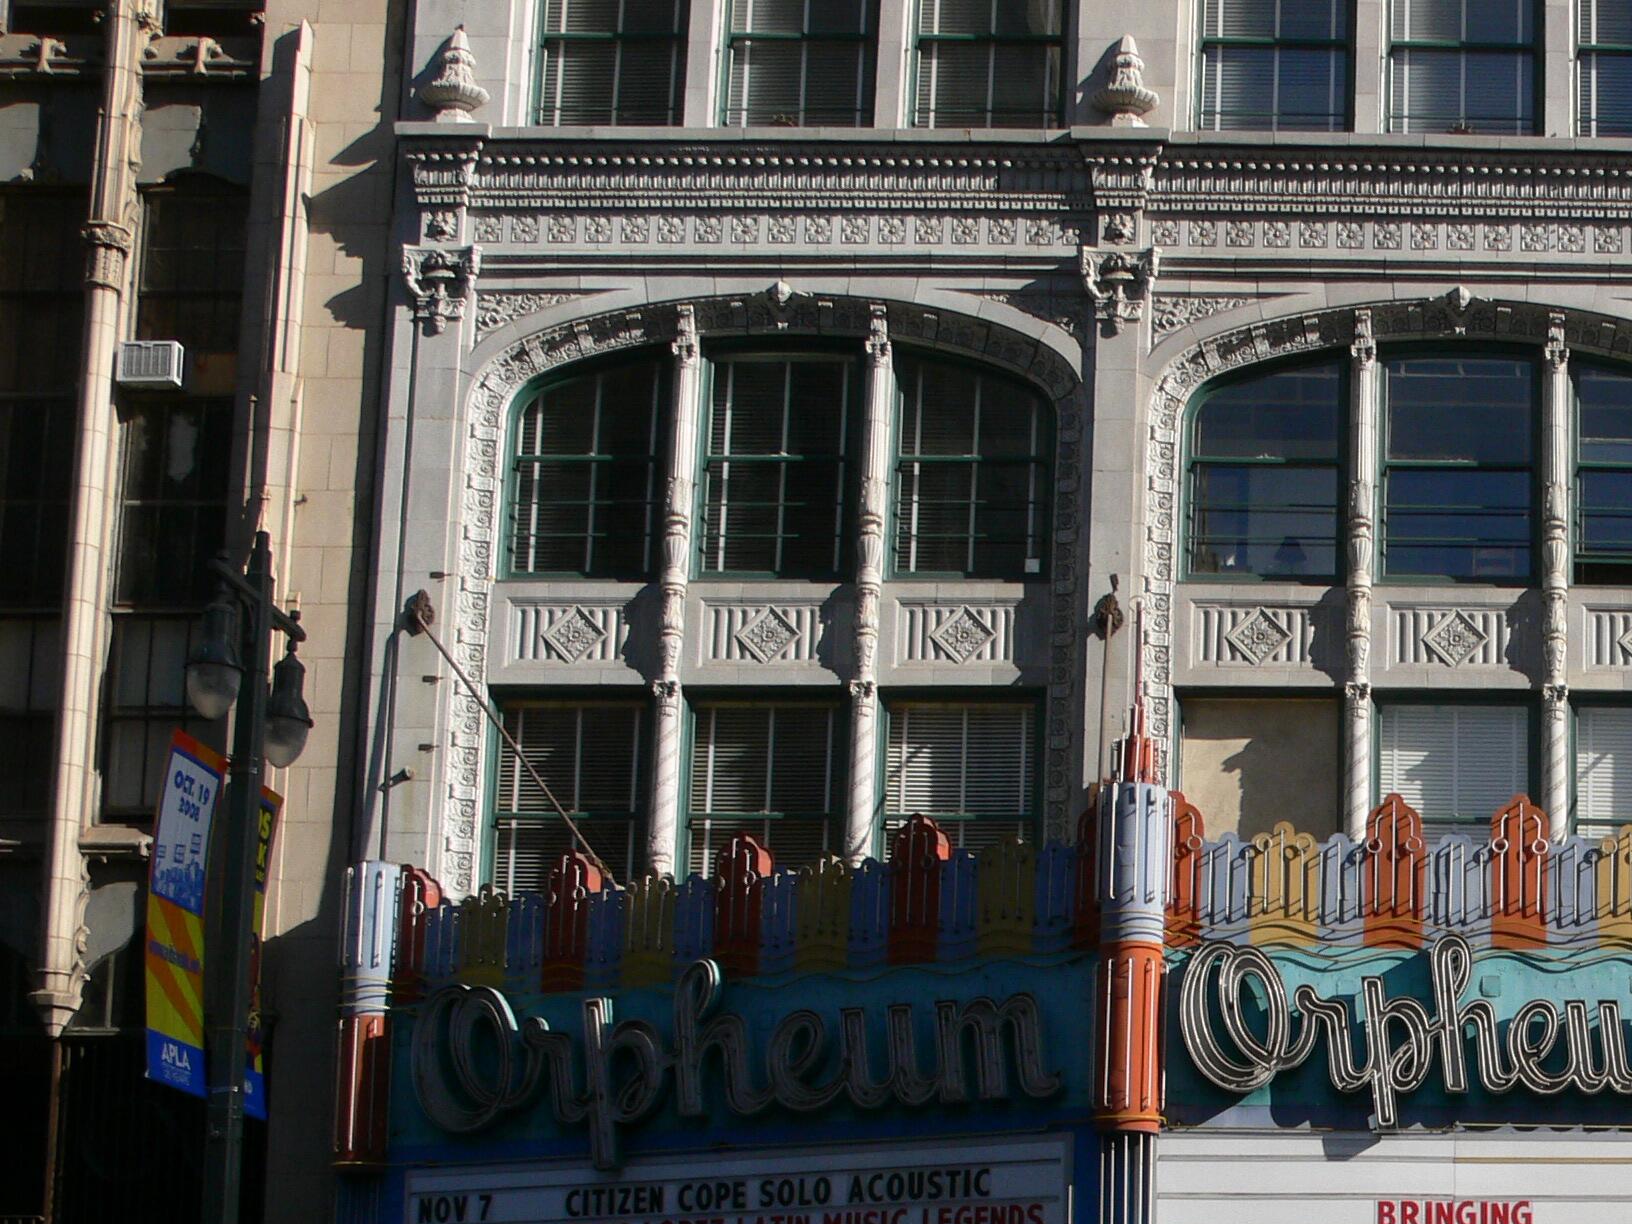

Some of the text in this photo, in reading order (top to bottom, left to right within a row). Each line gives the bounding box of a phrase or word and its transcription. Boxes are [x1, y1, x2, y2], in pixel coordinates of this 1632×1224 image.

[161, 1041, 192, 1071] APLA
[412, 958, 1063, 1170] Orpheum
[418, 1168, 991, 1224] NOV 7 CITIZEN COPE SOLO ACOUSTIC
